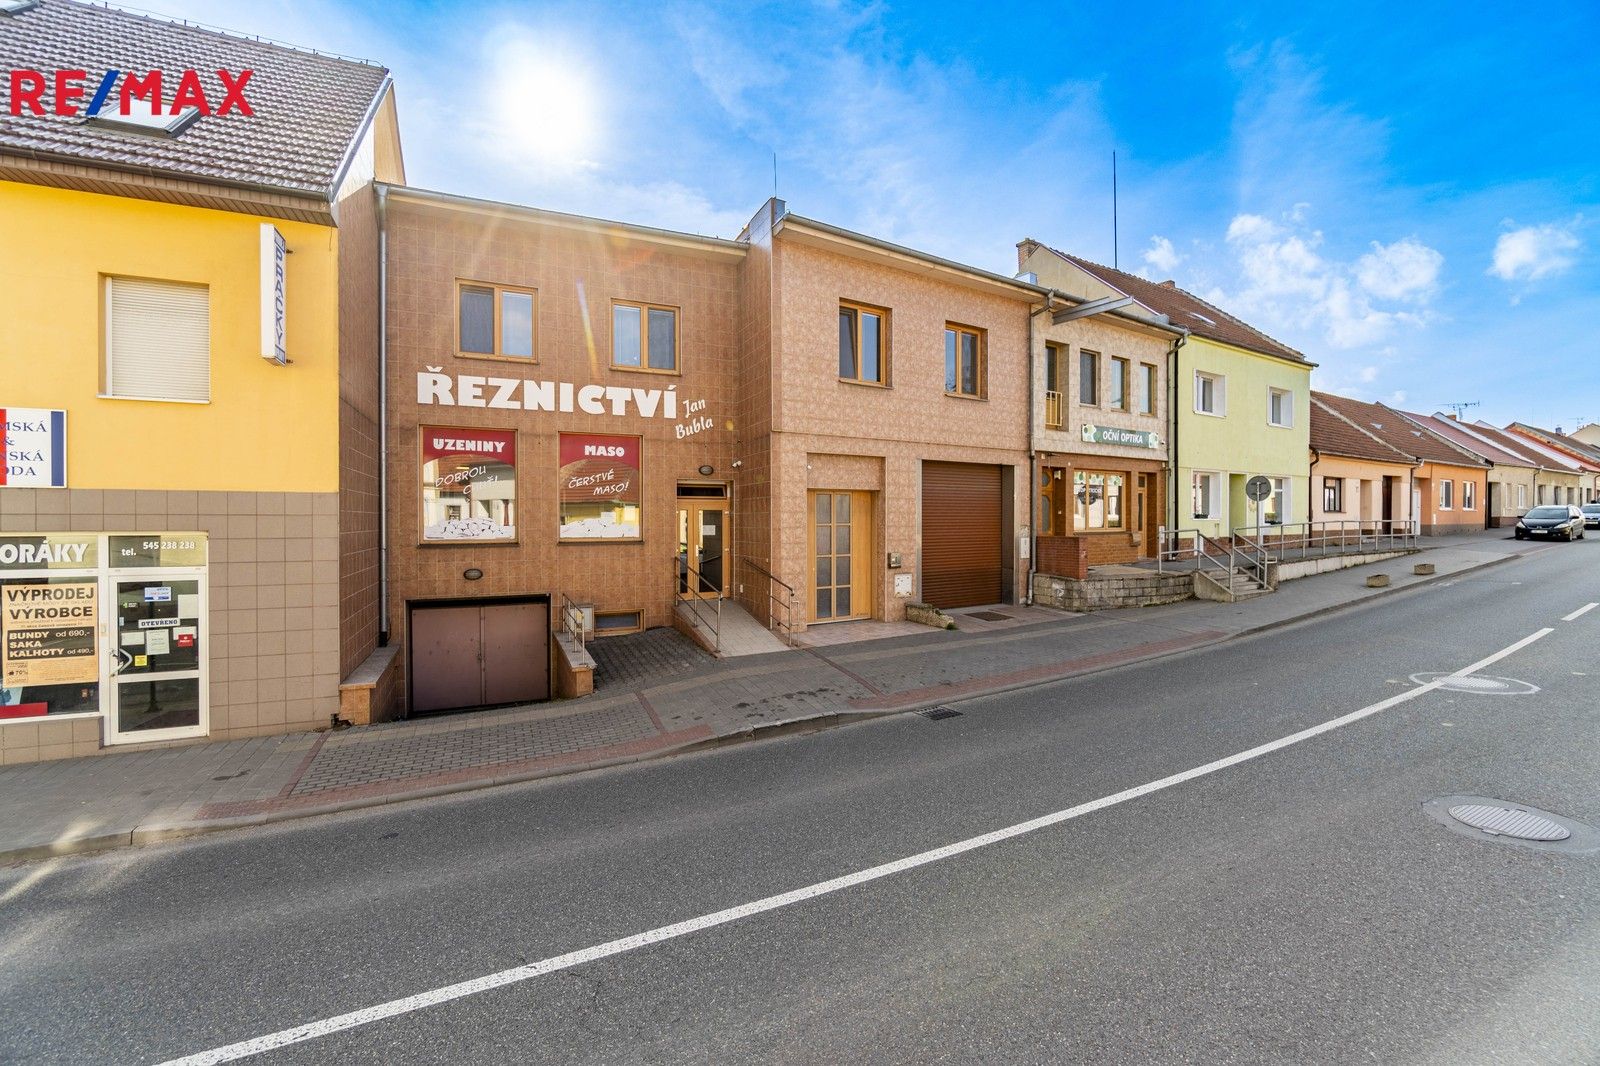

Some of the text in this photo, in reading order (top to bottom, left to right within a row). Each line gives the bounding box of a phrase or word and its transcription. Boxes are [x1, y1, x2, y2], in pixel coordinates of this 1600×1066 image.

[416, 365, 678, 419] ŘEZNICTVÍ
[682, 398, 706, 419] Jan
[674, 415, 714, 440] Bubla
[1103, 430, 1143, 443] OČNÍ OPTIKA
[432, 438, 506, 453] UZENINY
[584, 445, 625, 457] MASO
[435, 465, 487, 488] DOBROU
[568, 468, 615, 489] ČERSTVÉ
[593, 481, 629, 496] MASO!
[121, 541, 195, 556] tel. 545 238 238
[7, 587, 94, 601] VÝPRODEJ
[9, 606, 93, 620] VÝROBCE
[141, 618, 178, 627] OTEVŘENO
[9, 631, 50, 640] BUNDY
[9, 640, 42, 649] SAKA
[9, 648, 65, 658] KALHOTY
